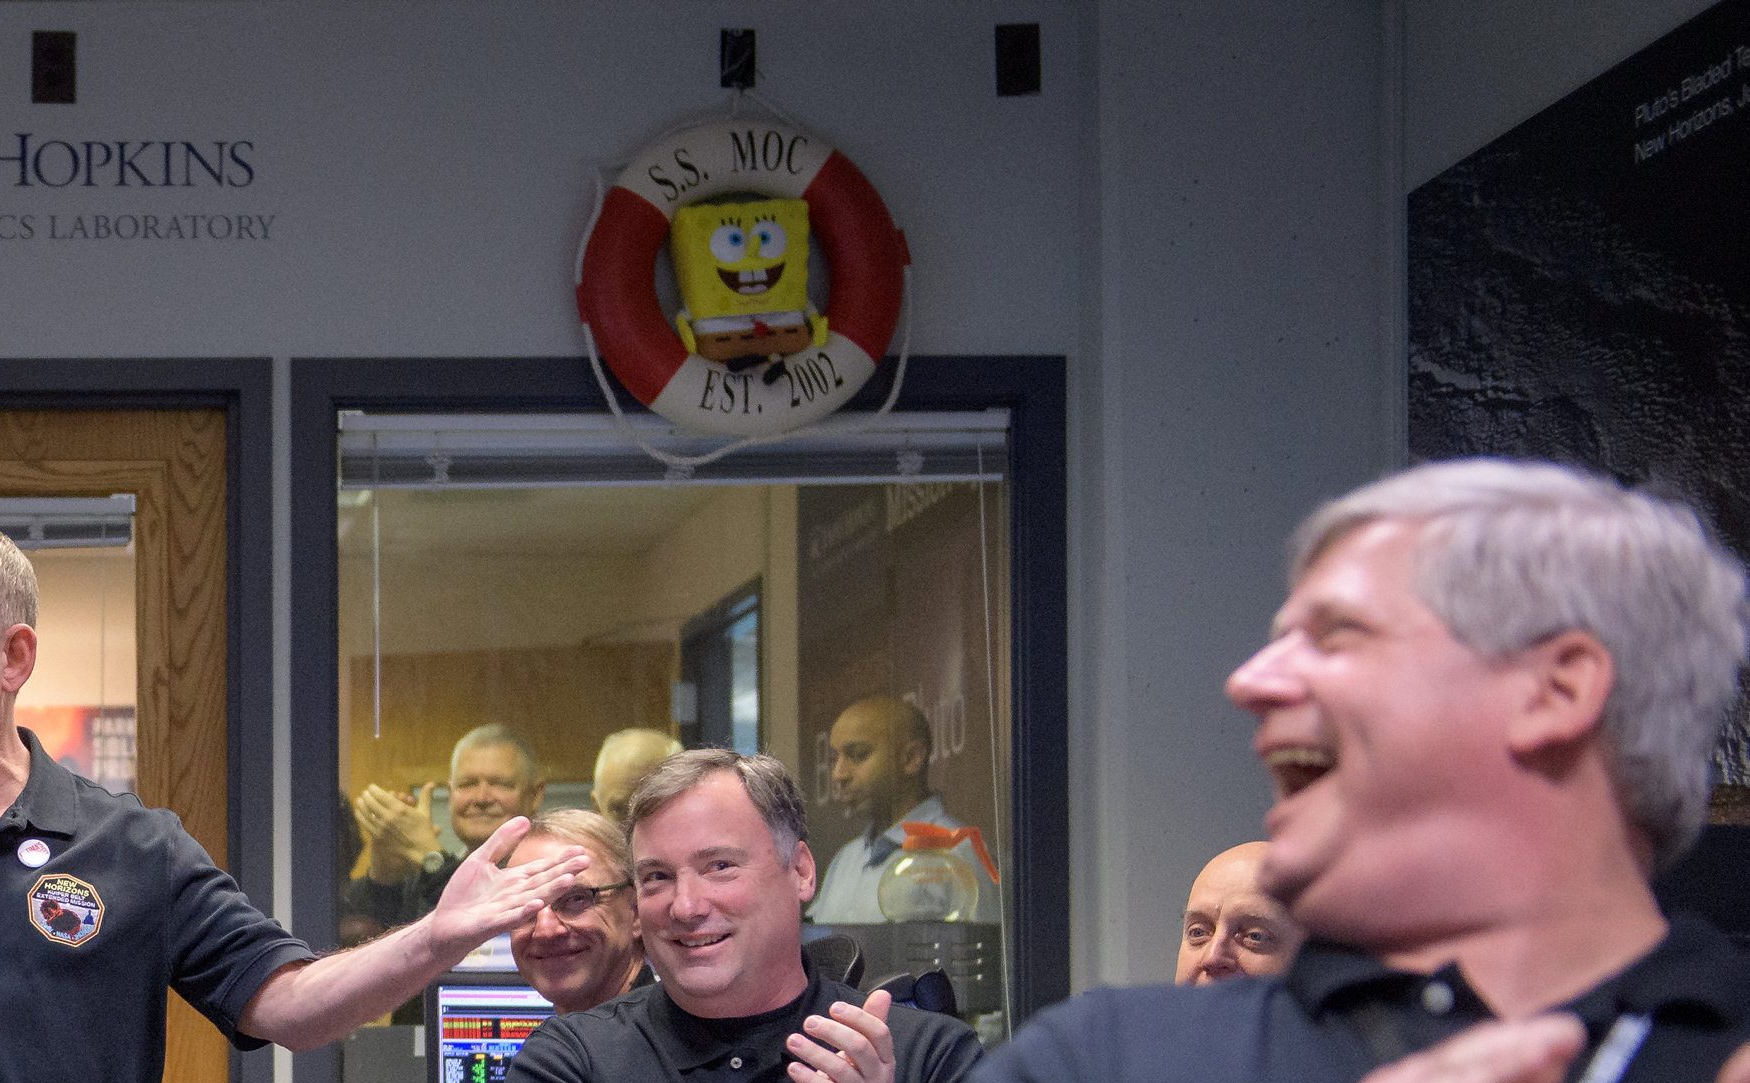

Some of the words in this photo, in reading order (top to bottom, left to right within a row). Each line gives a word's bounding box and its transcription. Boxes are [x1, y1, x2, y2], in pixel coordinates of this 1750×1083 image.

[1634, 88, 1679, 128] Pluto's
[1681, 54, 1732, 102] Bladed
[1634, 129, 1667, 165] New
[648, 149, 710, 202] S.S.
[730, 130, 808, 175] MOC
[49, 213, 277, 242] LABORATORY
[700, 369, 763, 414] EST.
[786, 350, 844, 409] 2002
[44, 882, 90, 897] HORIZONS
[47, 890, 69, 898] KUIPER
[56, 878, 78, 888] NEW
[36, 892, 70, 903] EXTENDED
[69, 898, 96, 908] MISSION
